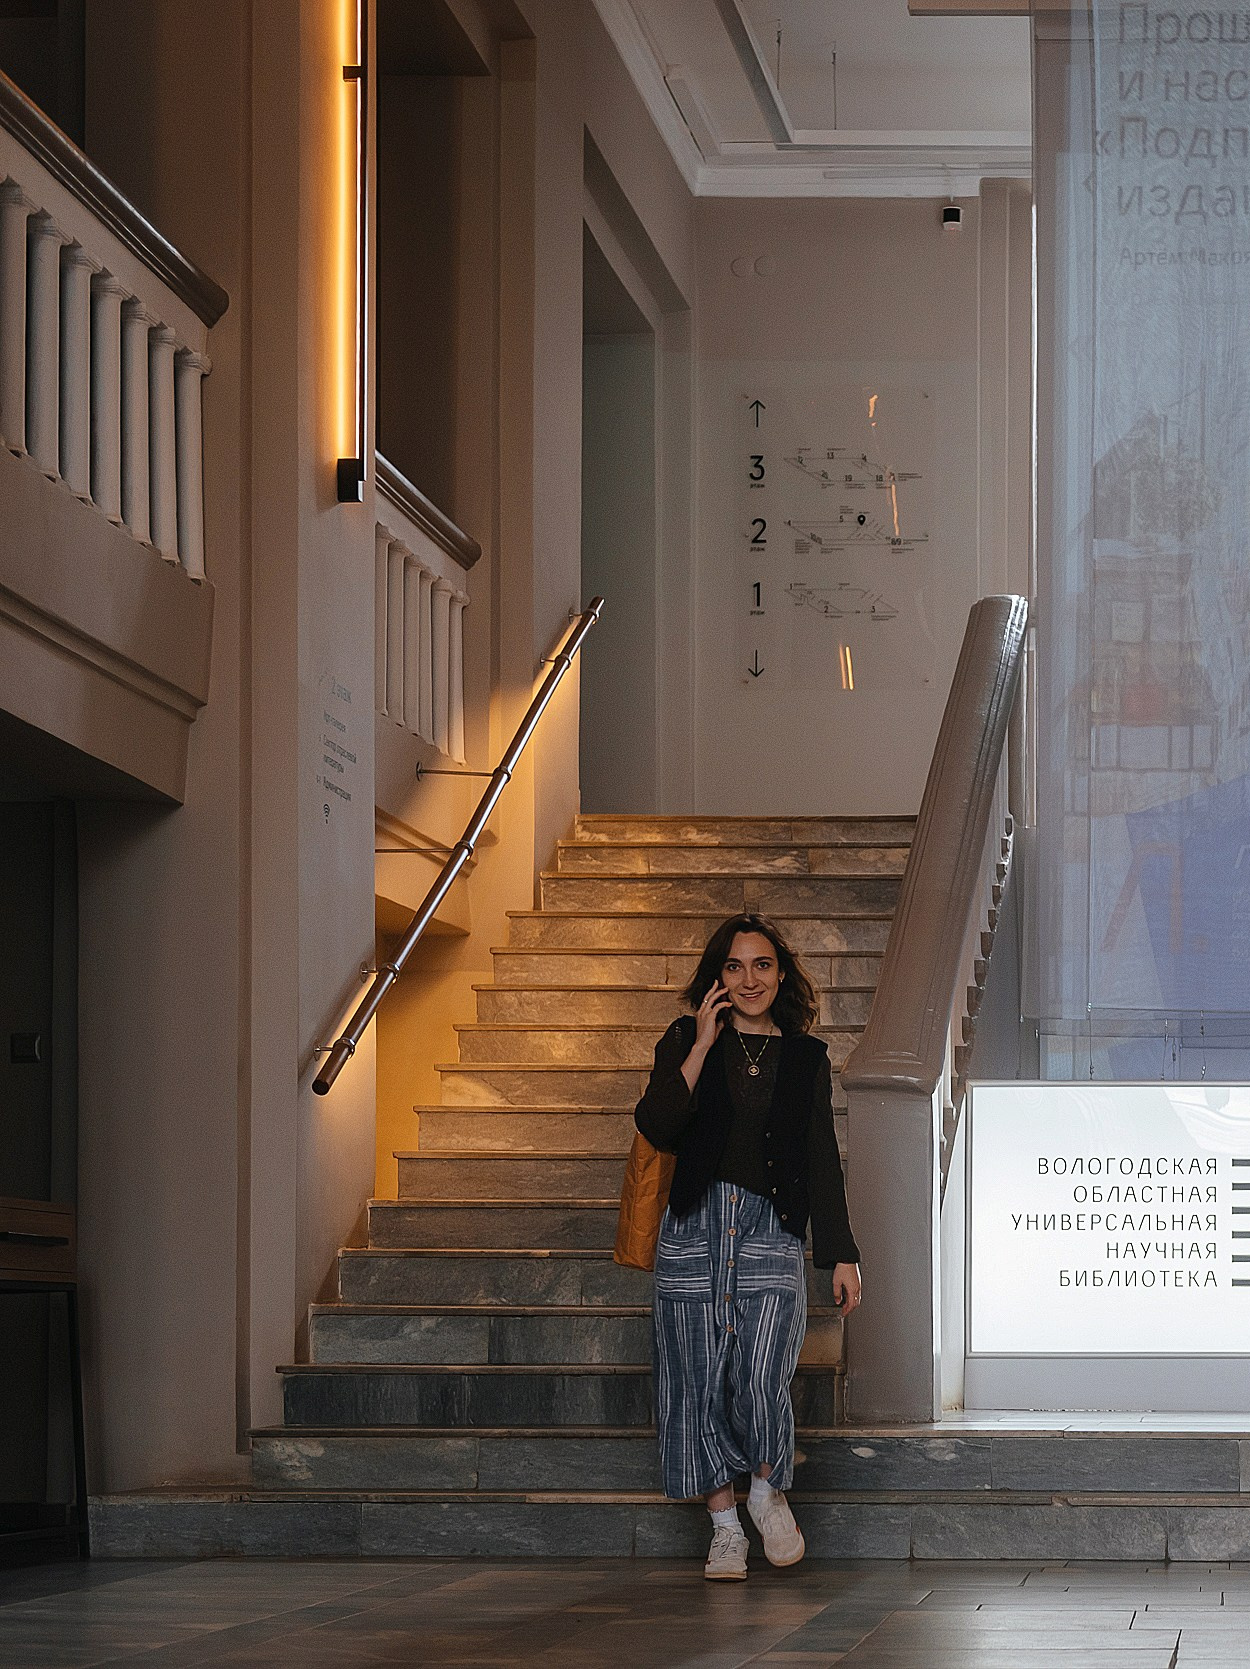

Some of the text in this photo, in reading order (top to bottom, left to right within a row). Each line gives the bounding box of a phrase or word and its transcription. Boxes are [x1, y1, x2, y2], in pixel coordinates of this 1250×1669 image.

[1117, 70, 1143, 101] и
[749, 455, 765, 480] 3
[751, 518, 767, 543] 2
[752, 582, 761, 607] 1
[1038, 1158, 1217, 1178] ВОЛОГОДСКАЯ
[1073, 1185, 1217, 1203] ОБЛАСТНАЯ
[1011, 1213, 1217, 1231] УНИВЕРСАЛЬНАЯ
[1106, 1242, 1217, 1259] НАУЧНАЯ
[1060, 1269, 1218, 1288] БИБЛИОТЕКА
